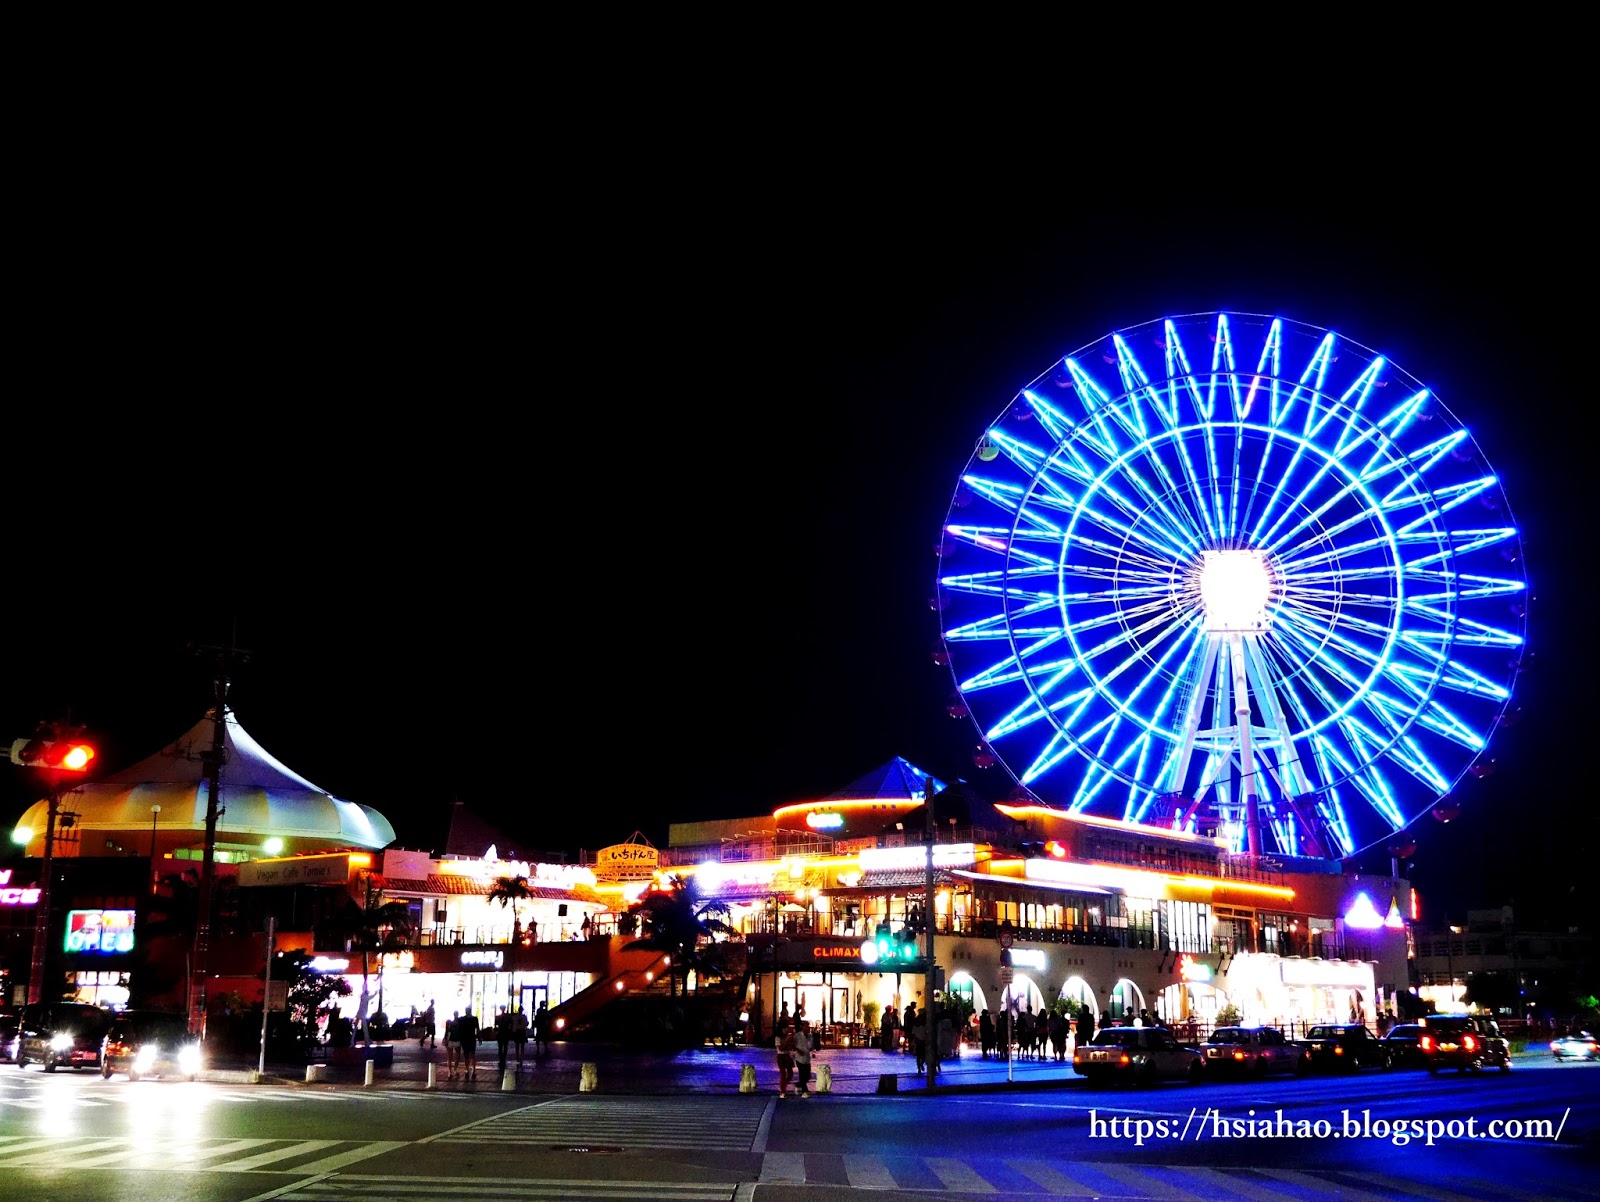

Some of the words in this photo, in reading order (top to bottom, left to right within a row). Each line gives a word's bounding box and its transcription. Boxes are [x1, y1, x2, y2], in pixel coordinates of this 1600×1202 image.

[611, 847, 656, 860] いちげん屋
[813, 947, 860, 957] CLIMAX
